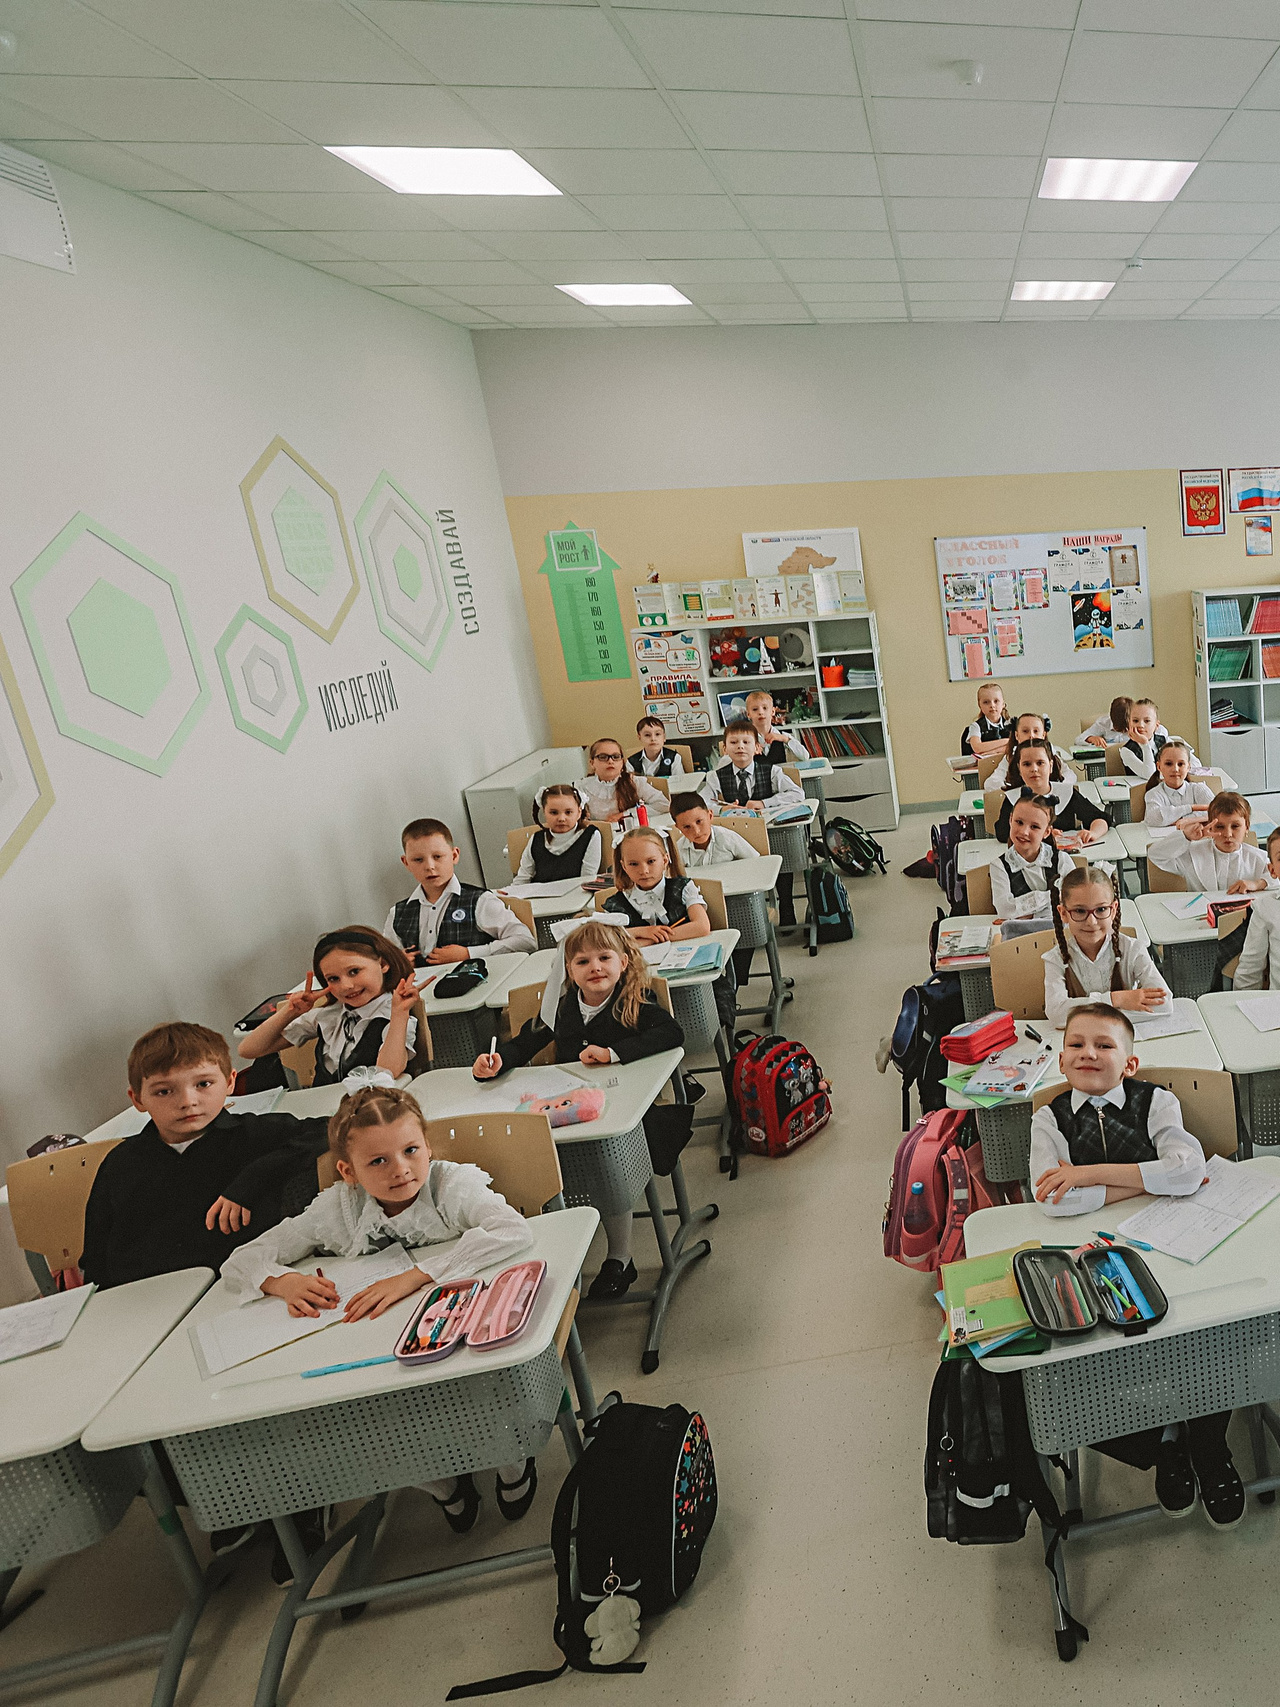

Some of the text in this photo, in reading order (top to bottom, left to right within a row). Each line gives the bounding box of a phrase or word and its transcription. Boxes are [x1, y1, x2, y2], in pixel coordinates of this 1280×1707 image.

[557, 539, 576, 551] МОЙ
[1063, 534, 1122, 546] НАШИ НАГРАДЫ
[559, 552, 580, 563] РОСТ
[435, 509, 480, 635] СОЗДАВАЙ
[585, 576, 596, 588] 180
[588, 591, 599, 602] 170
[590, 606, 602, 616] 160
[593, 620, 604, 631] 150
[595, 635, 607, 645] 140
[598, 649, 610, 659] 130
[601, 663, 612, 674] 120
[318, 660, 399, 732] ИССЛЕДУЙ
